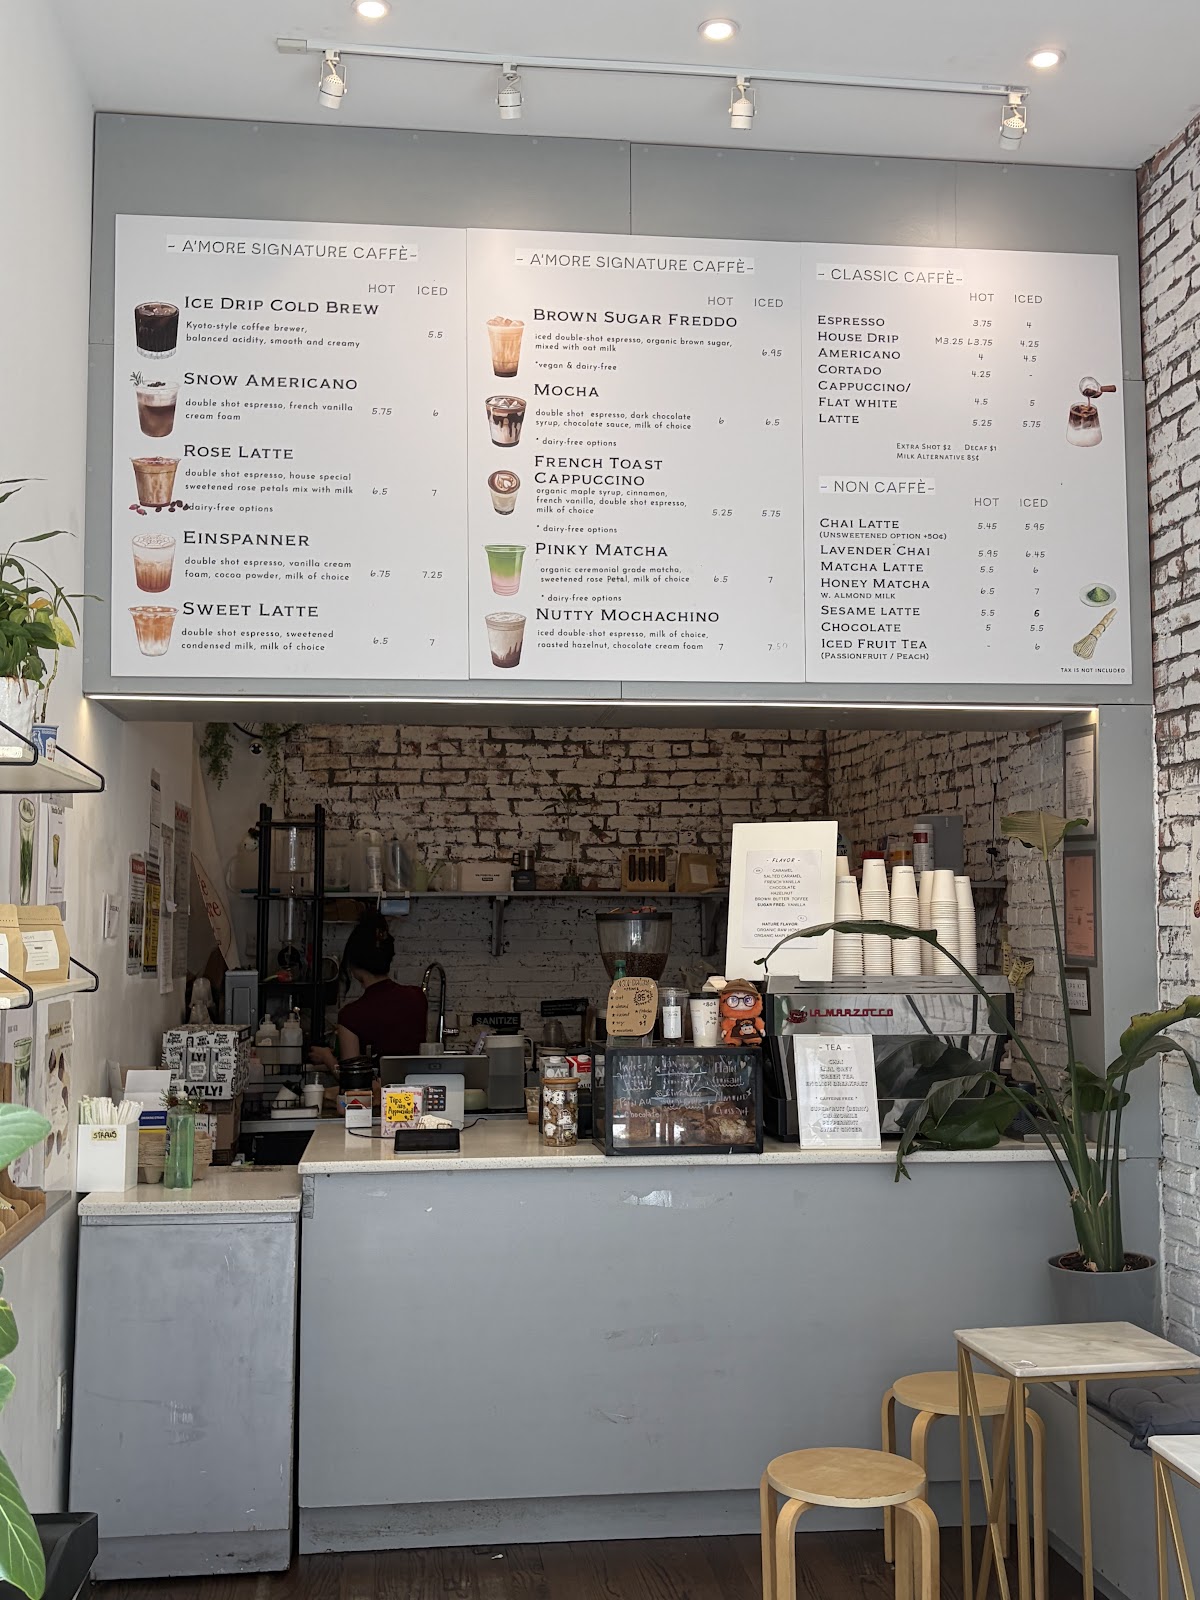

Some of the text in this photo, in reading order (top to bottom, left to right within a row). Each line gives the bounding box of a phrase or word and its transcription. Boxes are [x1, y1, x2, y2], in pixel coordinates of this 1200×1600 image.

[251, 242, 347, 258] SIGNATURE
[596, 256, 688, 271] SIGNATURE
[831, 268, 898, 282] CLASSIC
[368, 284, 396, 294] HOT
[417, 286, 448, 296] ICED
[707, 296, 734, 306] HOT
[969, 292, 995, 302] HOT
[1014, 294, 1043, 304] ICED
[185, 296, 379, 315] ICE DRIP COLD BREW
[754, 298, 784, 308] ICED
[533, 308, 737, 328] BROWN SUGAR FREDDO
[817, 315, 885, 327] ESPRESSO
[972, 319, 992, 328] 3.75
[186, 321, 307, 334] Kyoto-style coffee brewer,
[818, 331, 899, 343] HOUSE DRIP
[1020, 340, 1040, 348] 4.25
[761, 348, 782, 357] 6.95
[818, 348, 901, 360] AMERICANO
[817, 364, 882, 376] CORTADO
[971, 370, 991, 378] 4.25
[184, 372, 357, 390] SNOW AMERICANO
[534, 383, 599, 397] MOCHA
[185, 398, 353, 411] double shot espresso, french vanilla
[818, 397, 898, 408] FLAT WHITE
[217, 411, 241, 420] foam
[371, 407, 392, 416] 5.75
[819, 413, 859, 424] LATTE
[1022, 420, 1041, 428] 5.75
[184, 444, 293, 459] ROSE LATTE
[896, 442, 920, 450] EXTRA
[896, 452, 915, 460] MILK
[916, 453, 965, 461] ALTERNATIVE
[534, 455, 663, 470] FRENCH TOAST
[534, 472, 645, 486] CAPPUCCINO
[185, 482, 233, 491] sweetened
[260, 484, 289, 493] petals
[311, 485, 331, 493] with
[334, 486, 353, 494] milk
[834, 480, 869, 493] NON
[974, 497, 1000, 507] HOT
[1019, 498, 1049, 508] ICED
[711, 508, 733, 517] 5.25
[761, 509, 781, 518] 5.75
[819, 518, 899, 529] CHAI LATTE
[977, 522, 998, 530] 5.45
[183, 530, 310, 547] EINSPANNER
[819, 531, 888, 539] (UNSWEETENED
[535, 542, 668, 557] PINKY MATCHA
[820, 544, 930, 556] LAVENDER CHAI
[1025, 550, 1045, 558] 6.45
[821, 561, 924, 572] MATCHA LATTE
[370, 569, 391, 578] 6.75
[422, 571, 443, 579] 7.25
[821, 578, 930, 589] HONEY MATCHA
[182, 601, 319, 617] SWEET LATTE
[821, 605, 920, 616] SESAME LATTE
[536, 608, 719, 623] NUTTY MOCHACHINO
[821, 622, 901, 632] CHOCOLATE
[821, 638, 927, 649] ICED FRUIT TEA
[820, 652, 929, 661] (PASSIONFRUIT PEACH)
[825, 1008, 894, 1017] MARZOCCO
[476, 1016, 519, 1025] SANITIZE
